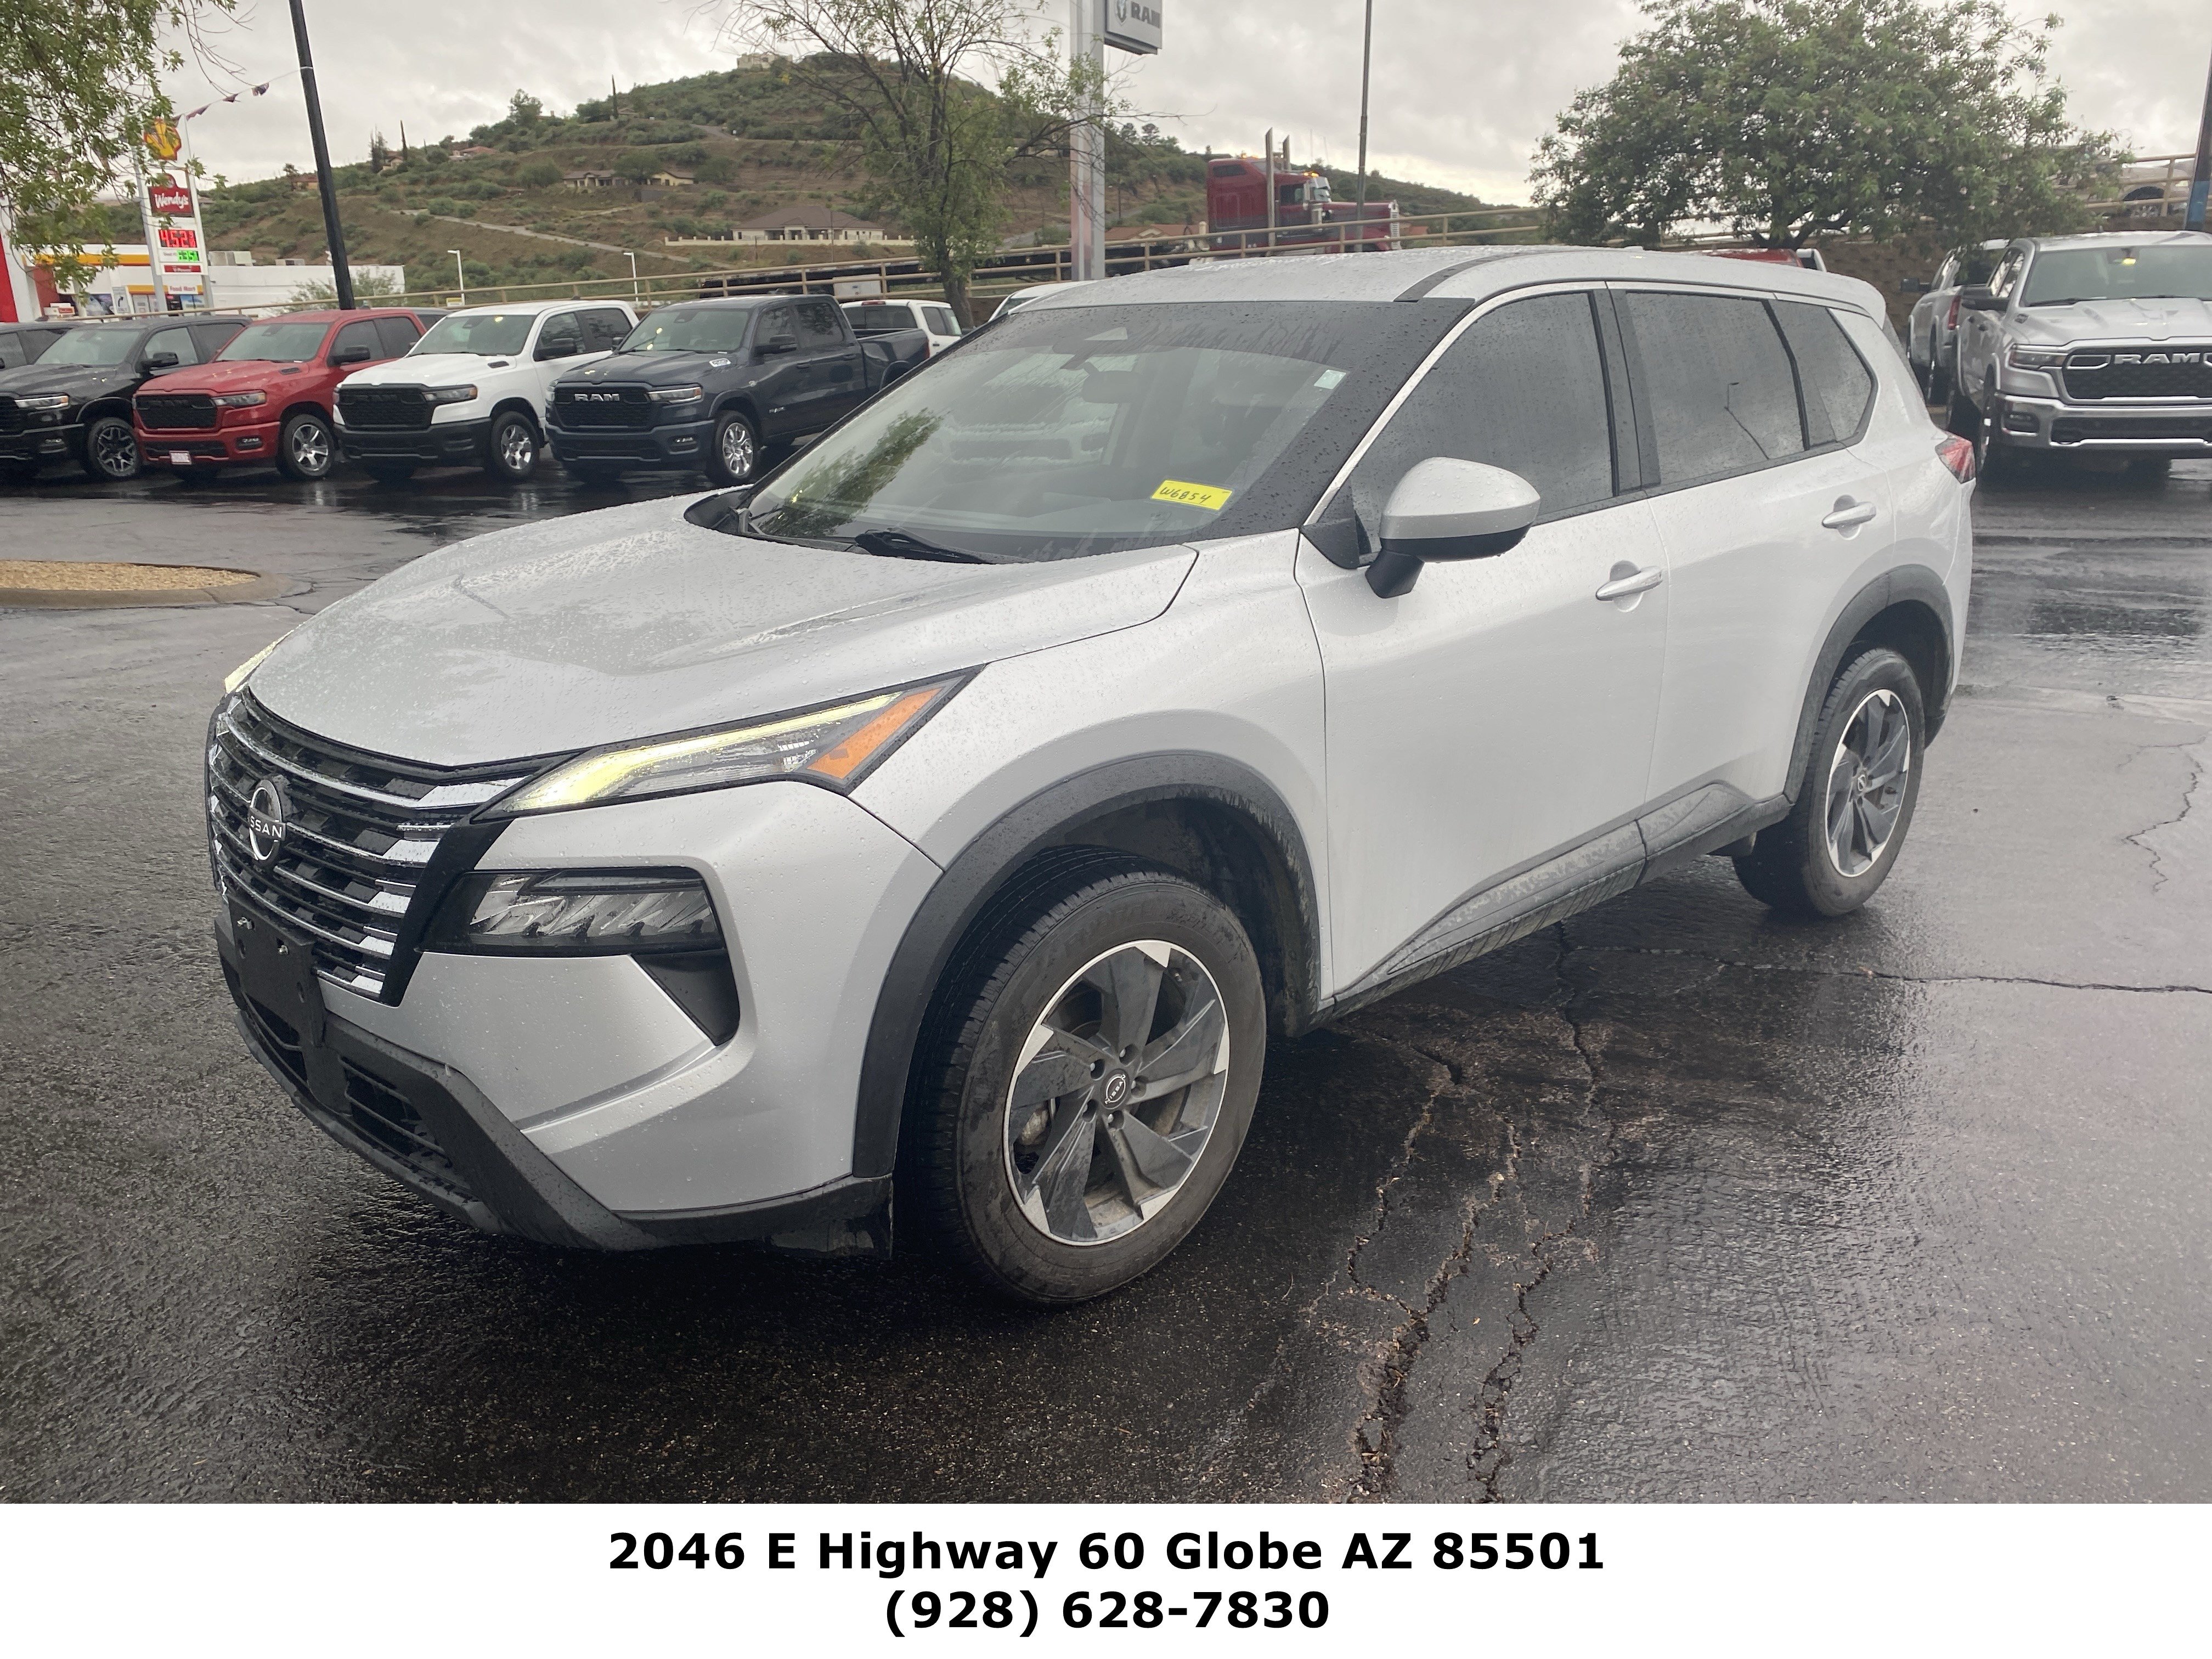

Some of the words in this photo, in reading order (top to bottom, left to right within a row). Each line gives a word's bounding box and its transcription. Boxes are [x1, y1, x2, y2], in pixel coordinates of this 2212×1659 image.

[1131, 1, 1161, 30] RAM
[154, 191, 189, 209] Wendy's
[2114, 353, 2201, 364] RAM
[1160, 487, 1211, 504] W6854
